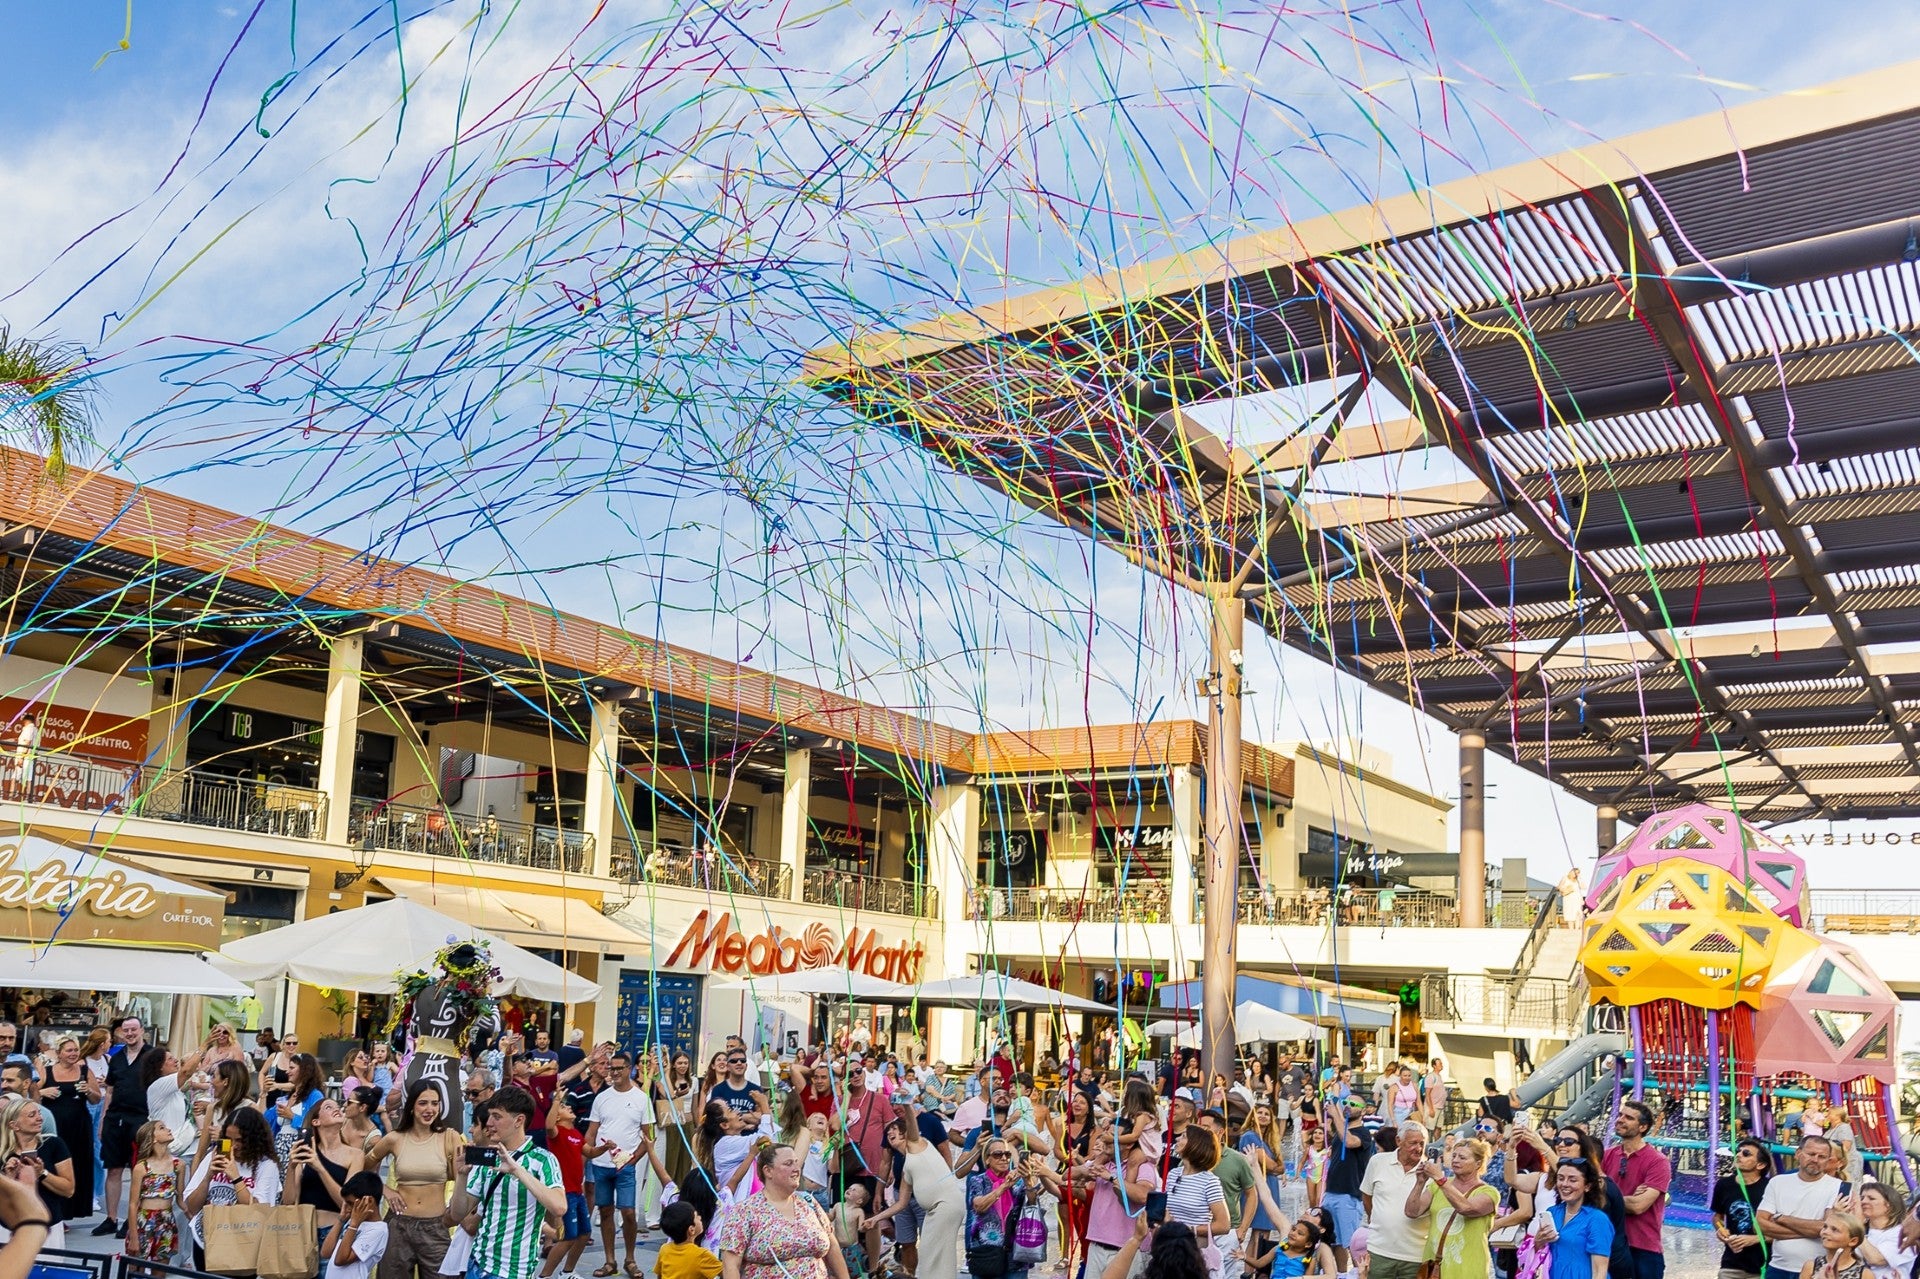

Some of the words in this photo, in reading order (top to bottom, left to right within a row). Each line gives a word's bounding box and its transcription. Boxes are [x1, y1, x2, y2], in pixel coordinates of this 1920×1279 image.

[232, 711, 253, 739] TGB
[292, 721, 308, 742] THE
[88, 736, 133, 750] DENTRO.
[1141, 826, 1174, 850] tap
[1347, 857, 1365, 874] My
[1367, 855, 1404, 875] tapa
[162, 911, 190, 923] CARTE
[191, 914, 214, 928] D'OR
[216, 1222, 260, 1231] PRIMARK
